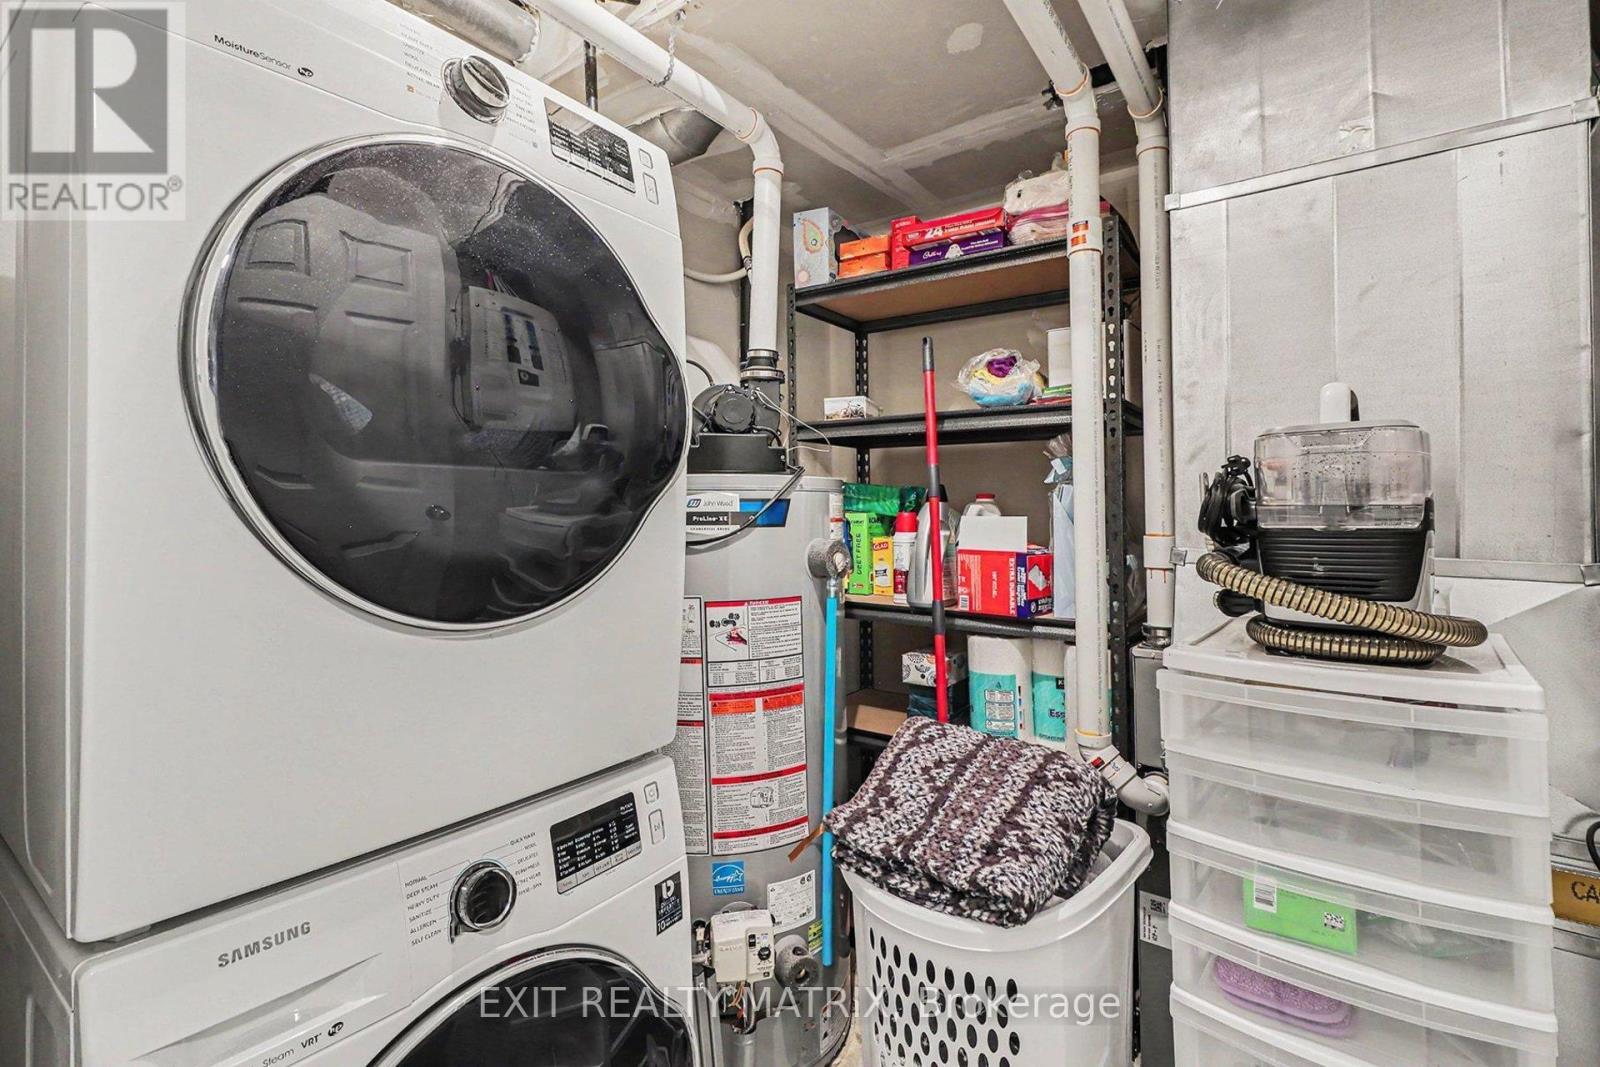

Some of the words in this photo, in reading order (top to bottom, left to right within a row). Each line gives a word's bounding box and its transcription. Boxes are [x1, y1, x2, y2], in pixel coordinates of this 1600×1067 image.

[214, 35, 291, 70] MoistureSensor
[873, 541, 888, 551] GLAD
[217, 921, 311, 968] SAMSUNG
[262, 1048, 294, 1067] Steam
